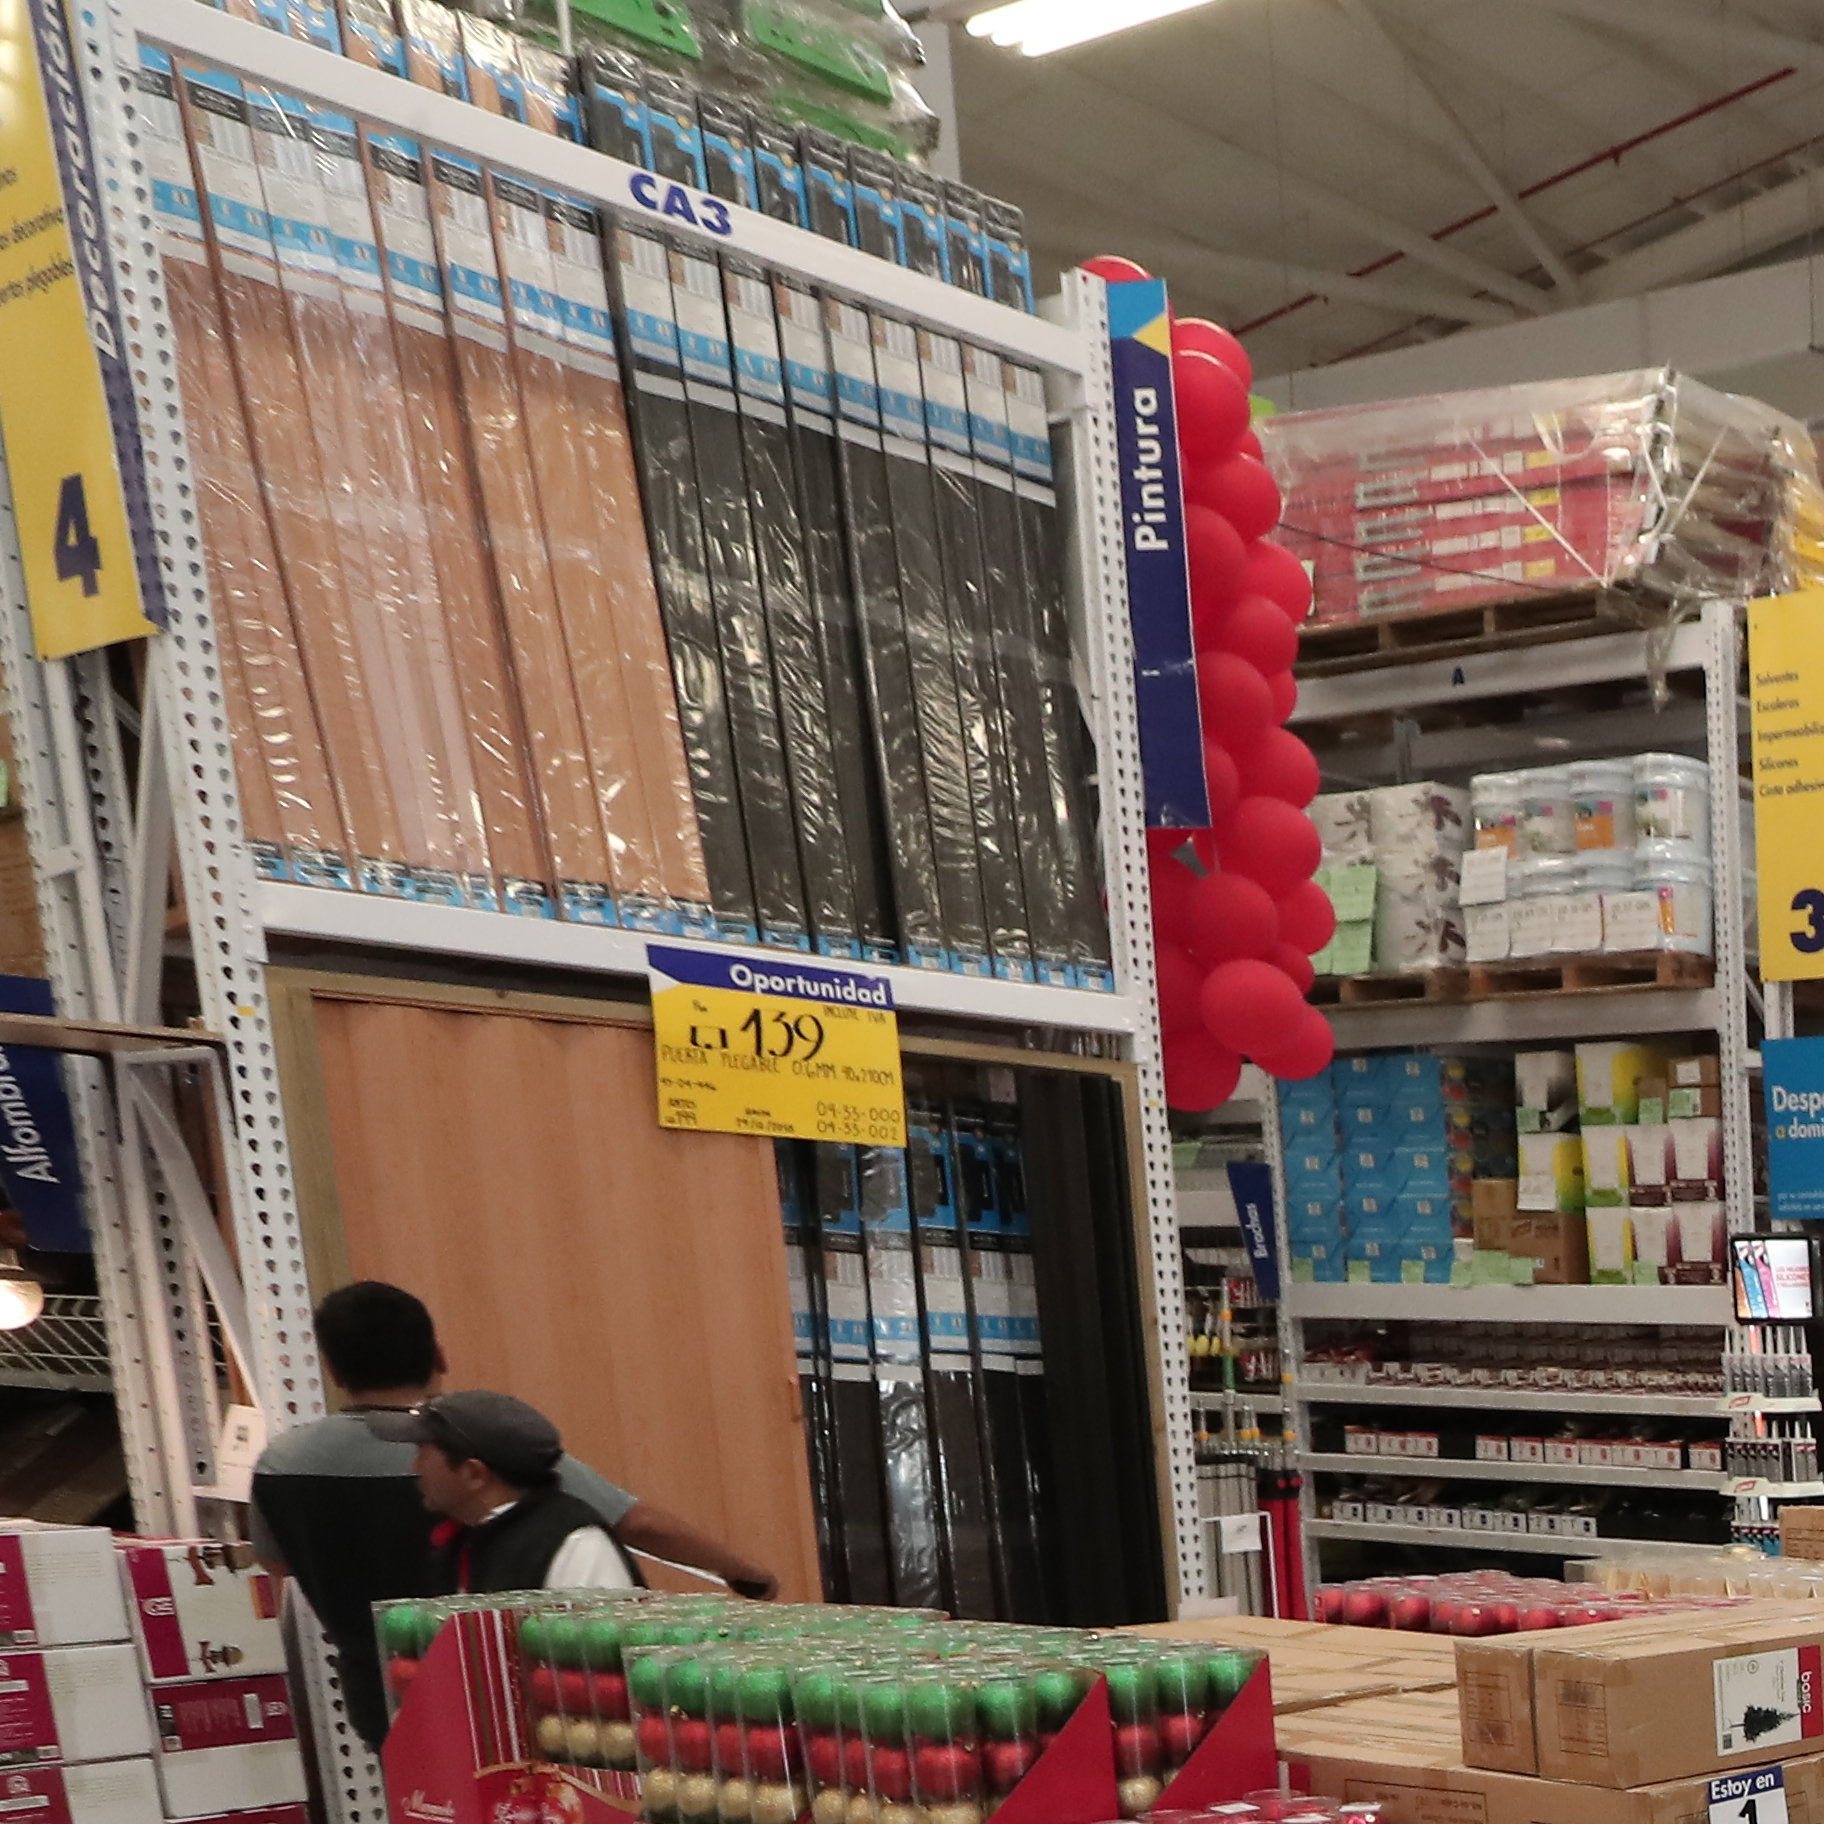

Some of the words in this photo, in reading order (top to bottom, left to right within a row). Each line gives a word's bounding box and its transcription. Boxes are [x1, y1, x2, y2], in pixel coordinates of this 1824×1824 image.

[629, 172, 735, 239] CA3
[1134, 383, 1169, 553] Pintura
[53, 471, 104, 599] 4
[1756, 697, 1800, 714] Escaleras
[730, 964, 887, 1005] Oportunidad
[741, 1008, 824, 1062] 139
[1244, 1202, 1269, 1260] Brochas
[1801, 1671, 1814, 1715] basic
[1711, 1777, 1752, 1801] Estoy
[1755, 1772, 1775, 1790] en
